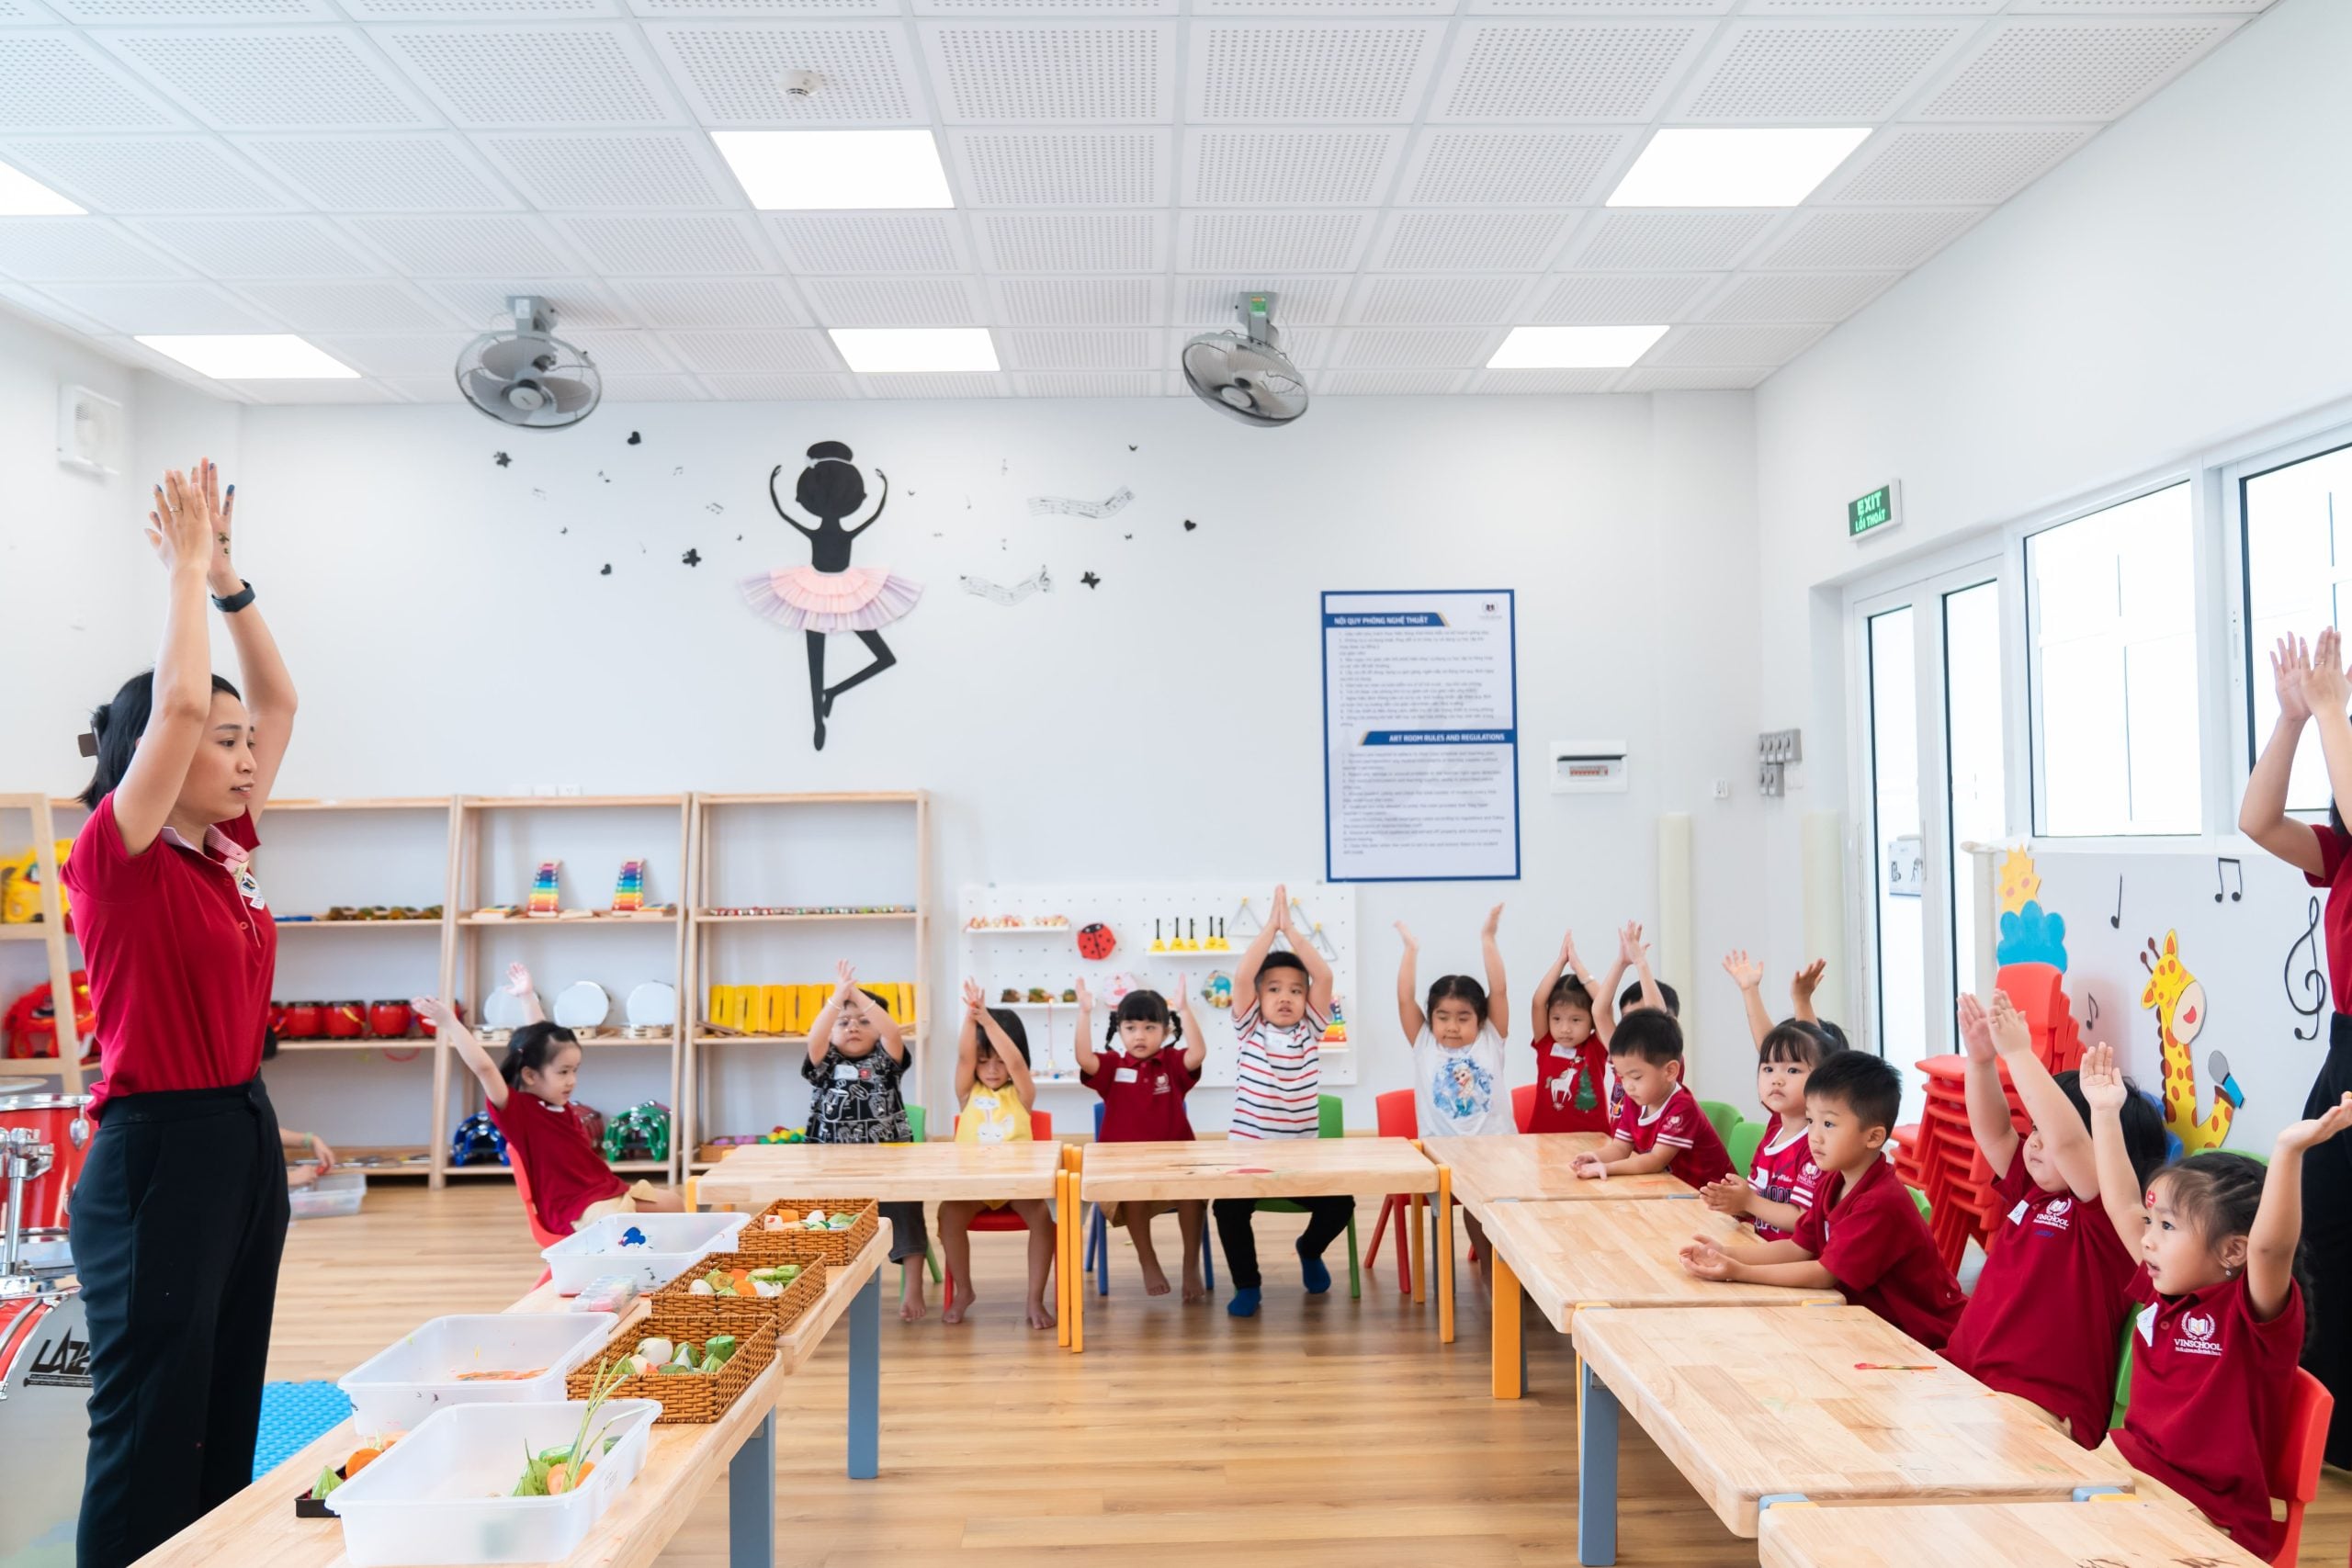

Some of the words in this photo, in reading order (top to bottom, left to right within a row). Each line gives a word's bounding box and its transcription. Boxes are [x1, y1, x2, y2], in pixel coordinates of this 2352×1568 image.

[1857, 491, 1882, 515] EXIT
[1347, 616, 1362, 626] QUY
[1403, 734, 1423, 742] ROOM
[1424, 734, 1444, 742] RULES
[1461, 733, 1505, 741] REGULATIONS
[29, 1325, 90, 1375] LAZE
[2174, 1338, 2222, 1351] VINSCHOOL
